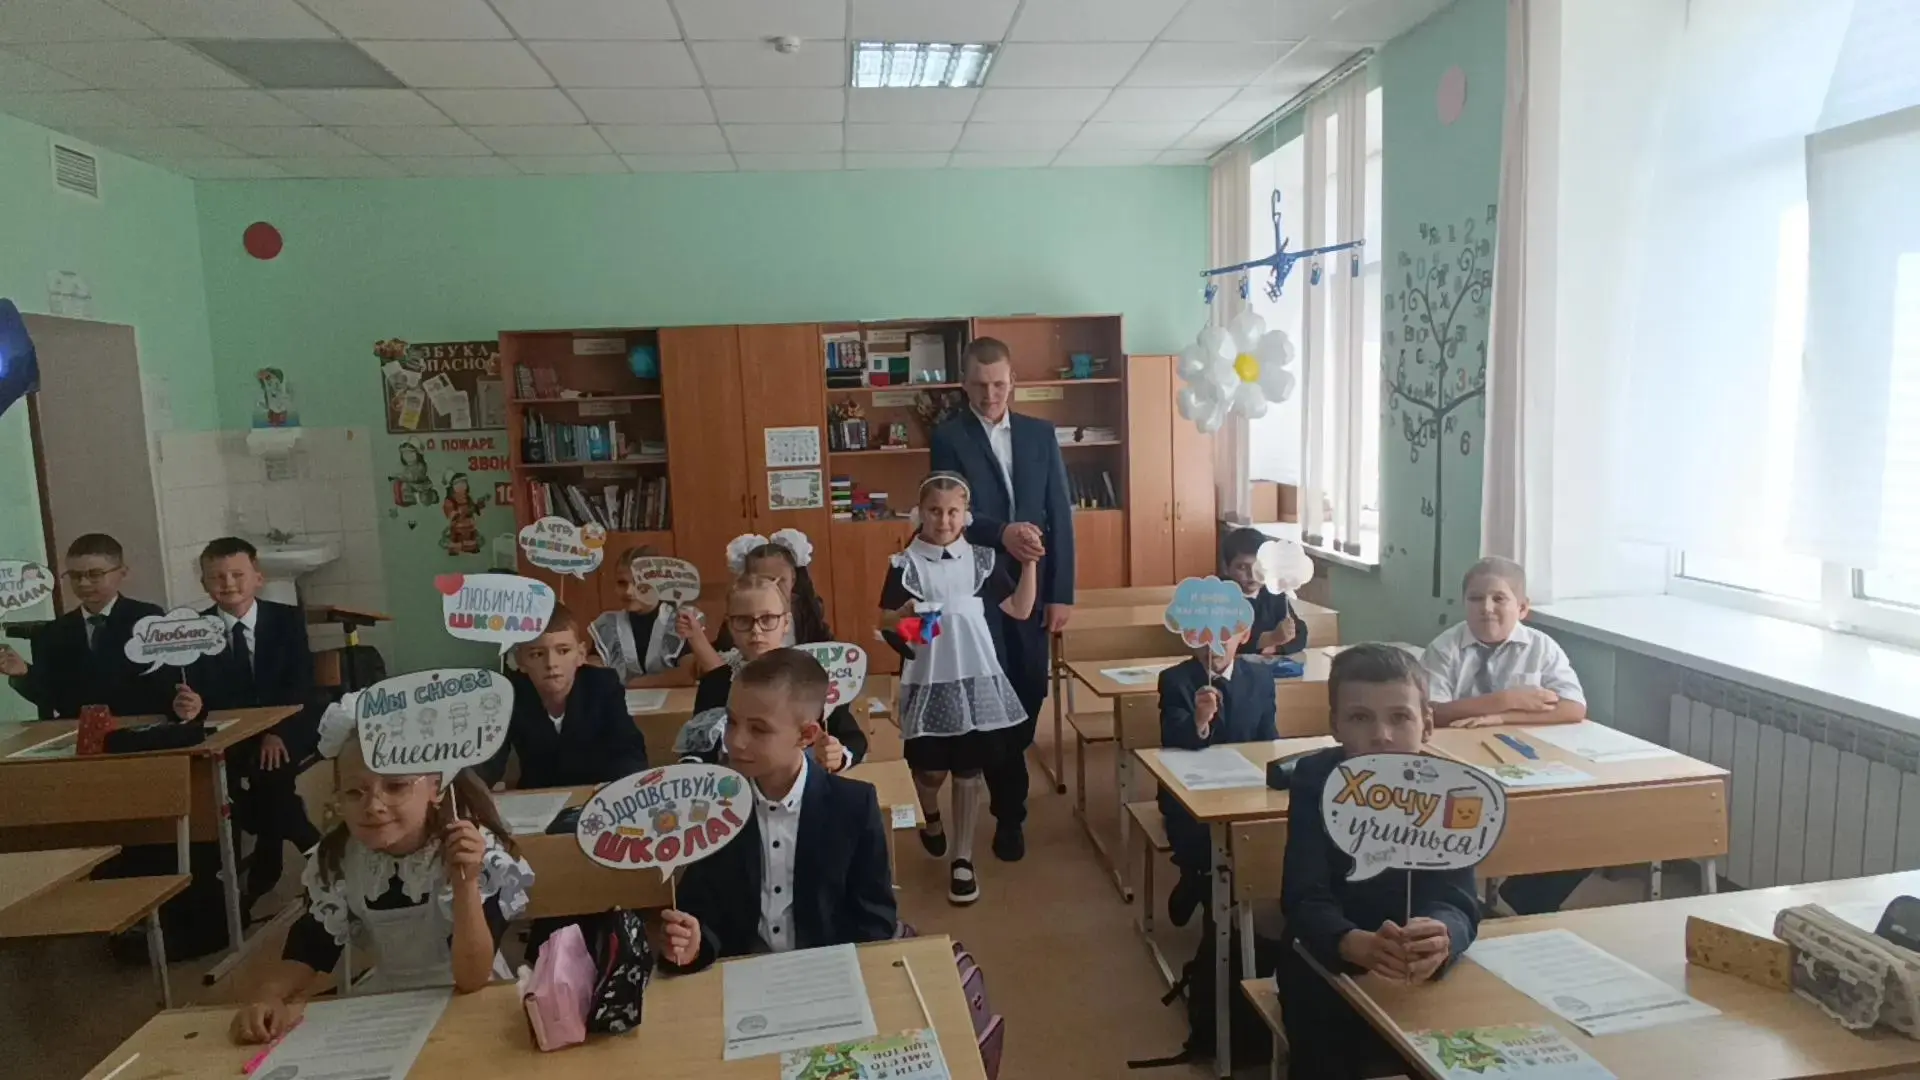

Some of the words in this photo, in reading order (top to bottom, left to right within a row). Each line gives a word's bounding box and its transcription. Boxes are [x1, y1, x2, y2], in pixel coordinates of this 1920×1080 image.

[420, 344, 489, 359] ЗБУКА
[441, 437, 496, 451] ПОЖАРЕ
[1460, 430, 1471, 456] 6
[468, 455, 510, 471] ЗВОН
[456, 584, 535, 613] ЛЮБИМАЯ
[448, 615, 543, 633] ШКОЛА!
[361, 687, 407, 719] Мы
[371, 726, 483, 769] вместе!
[1332, 764, 1442, 828] Хочу
[593, 807, 743, 864] ШКОЛА!
[1349, 816, 1488, 857] учиться!
